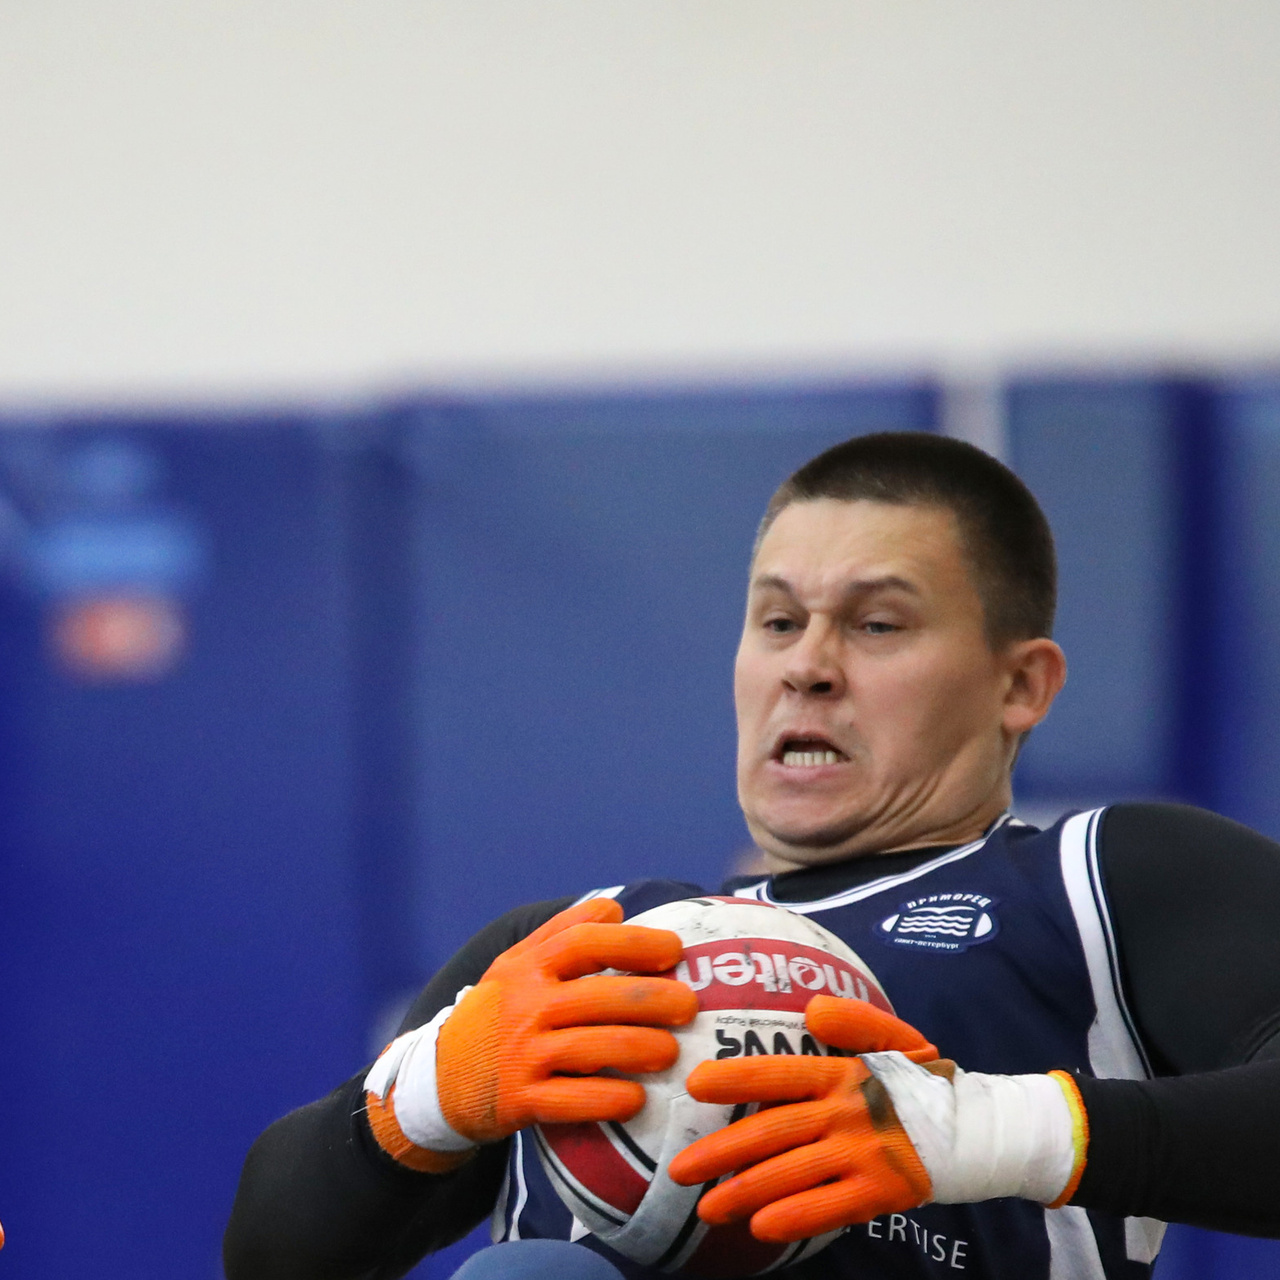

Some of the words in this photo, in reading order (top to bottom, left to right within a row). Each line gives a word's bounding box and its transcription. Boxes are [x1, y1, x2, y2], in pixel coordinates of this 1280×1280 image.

[676, 951, 870, 1003] molten
[715, 1015, 746, 1027] Rugby
[846, 1213, 969, 1270] ERTISE
